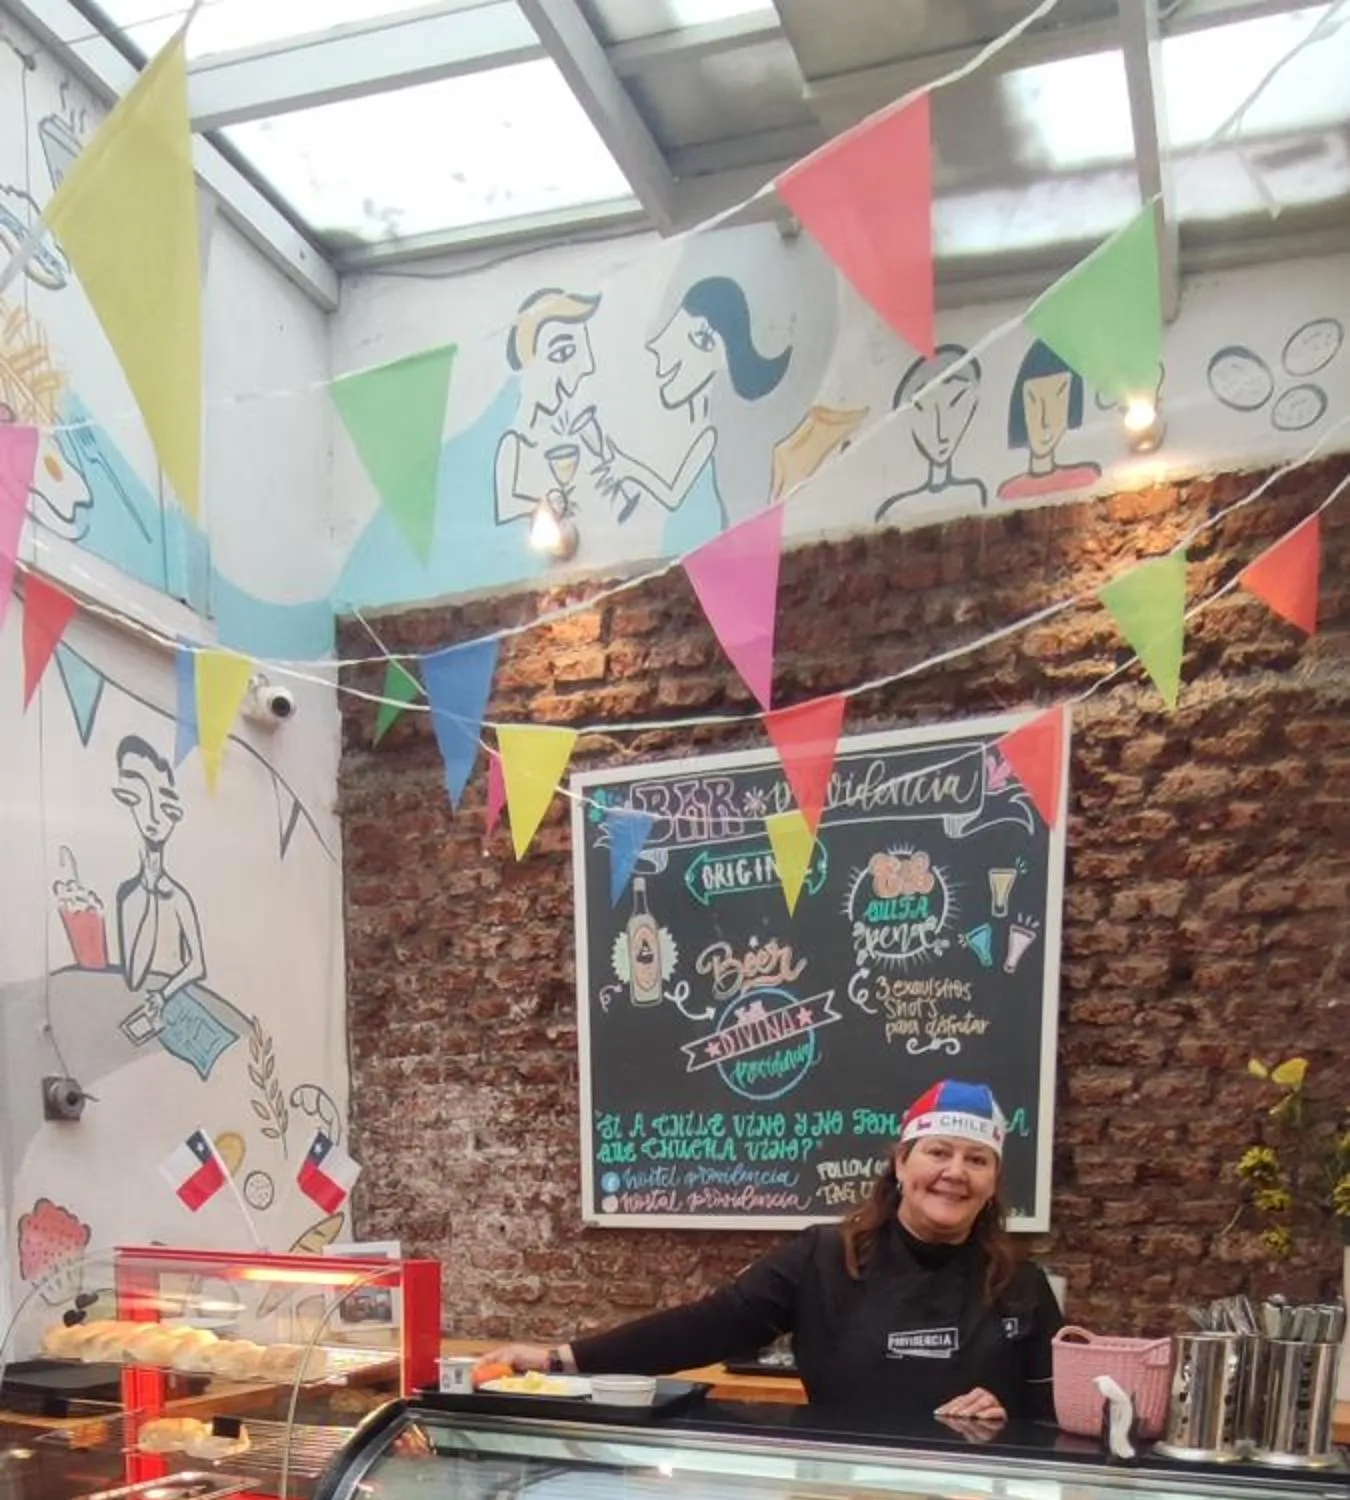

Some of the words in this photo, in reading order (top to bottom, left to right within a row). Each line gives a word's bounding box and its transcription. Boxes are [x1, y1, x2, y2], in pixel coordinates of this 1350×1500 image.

[631, 778, 744, 843] BAR
[766, 759, 978, 813] pvidencia
[702, 854, 811, 890] ORIGIN
[696, 937, 807, 999] Beer
[875, 975, 890, 1000] 3
[719, 1008, 795, 1056] DIVINA
[885, 1021, 921, 1044] para
[629, 1112, 647, 1138] A
[652, 1112, 726, 1138] CHILE
[733, 1111, 786, 1138] VINO
[811, 1110, 844, 1136] NO
[939, 1114, 988, 1133] CHILE
[816, 1156, 873, 1181] FOLLOW
[816, 1182, 858, 1205] TAG
